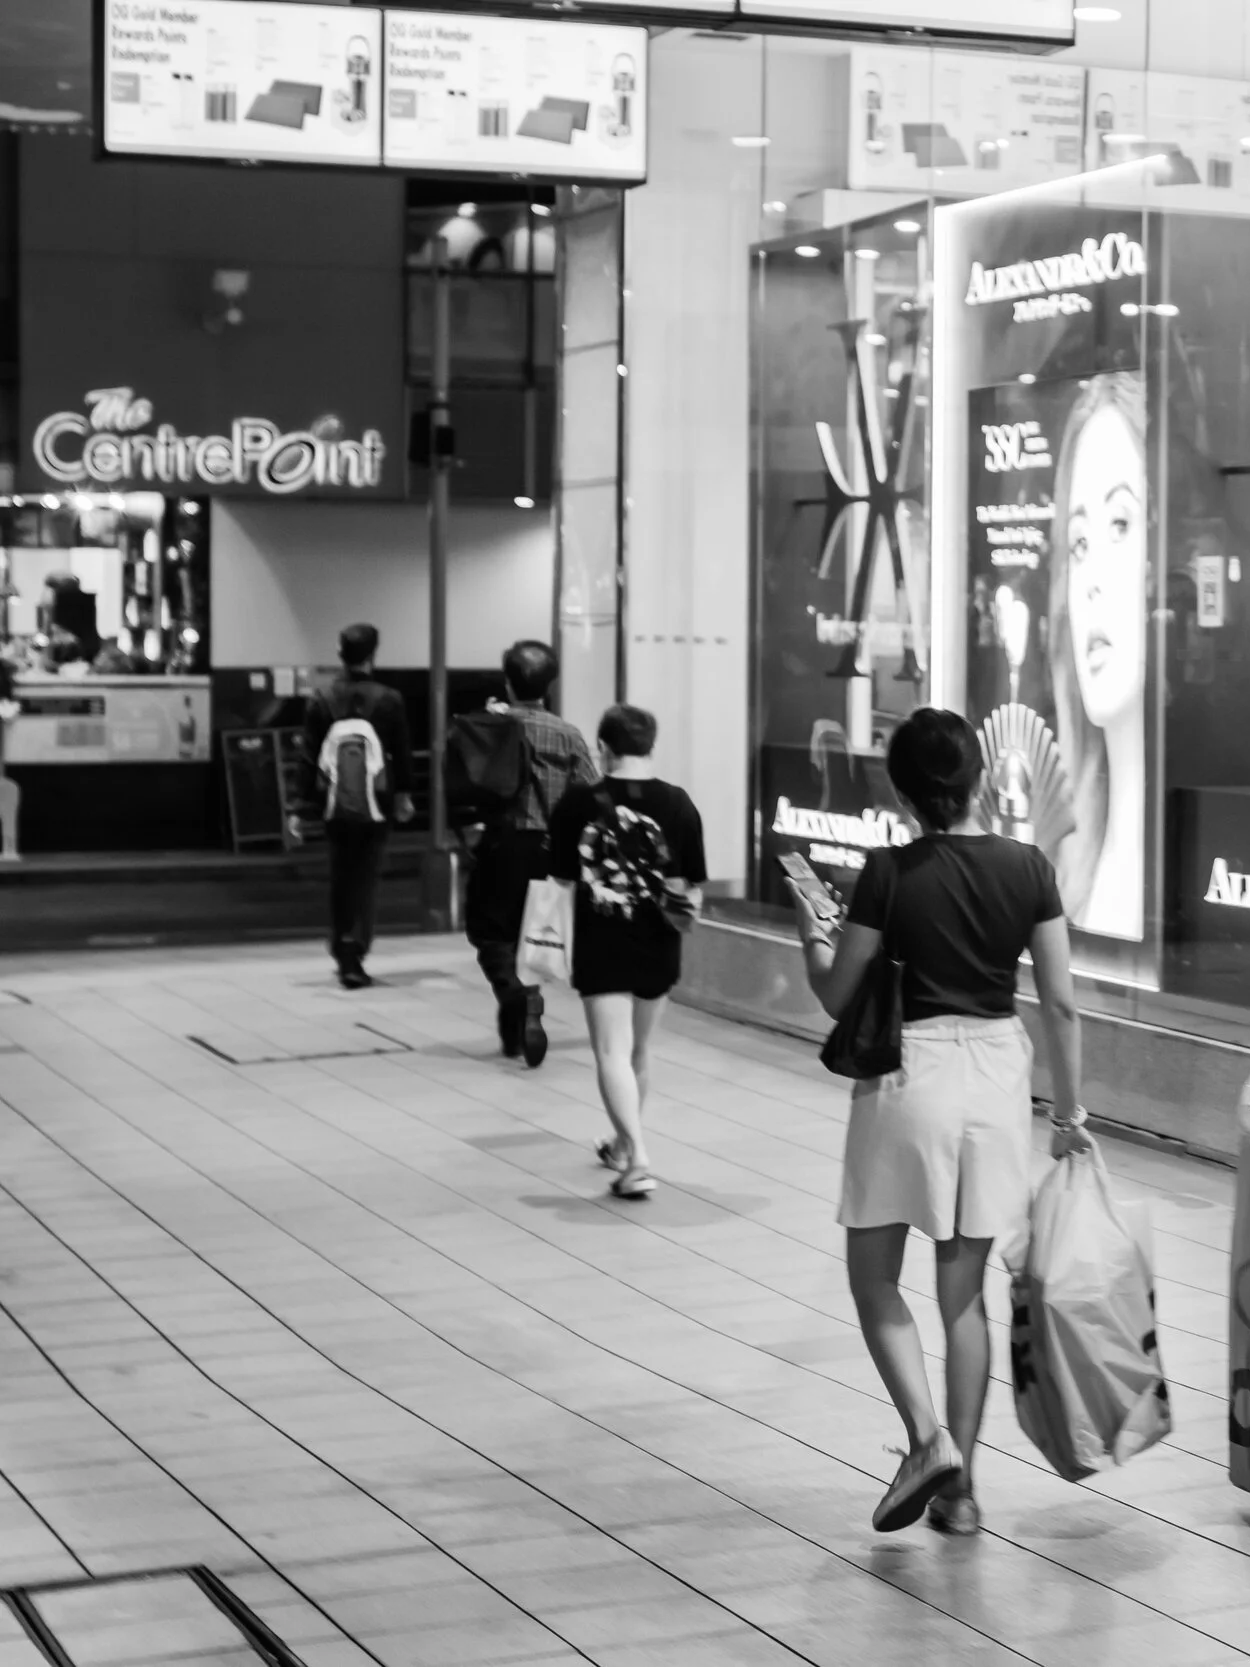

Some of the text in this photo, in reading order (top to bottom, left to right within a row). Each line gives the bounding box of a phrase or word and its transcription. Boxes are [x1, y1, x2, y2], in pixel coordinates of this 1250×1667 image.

[159, 8, 199, 24] Member
[111, 24, 187, 44] Rewards Points
[435, 25, 472, 42] Member
[111, 44, 171, 64] Redemption
[84, 386, 153, 431] The
